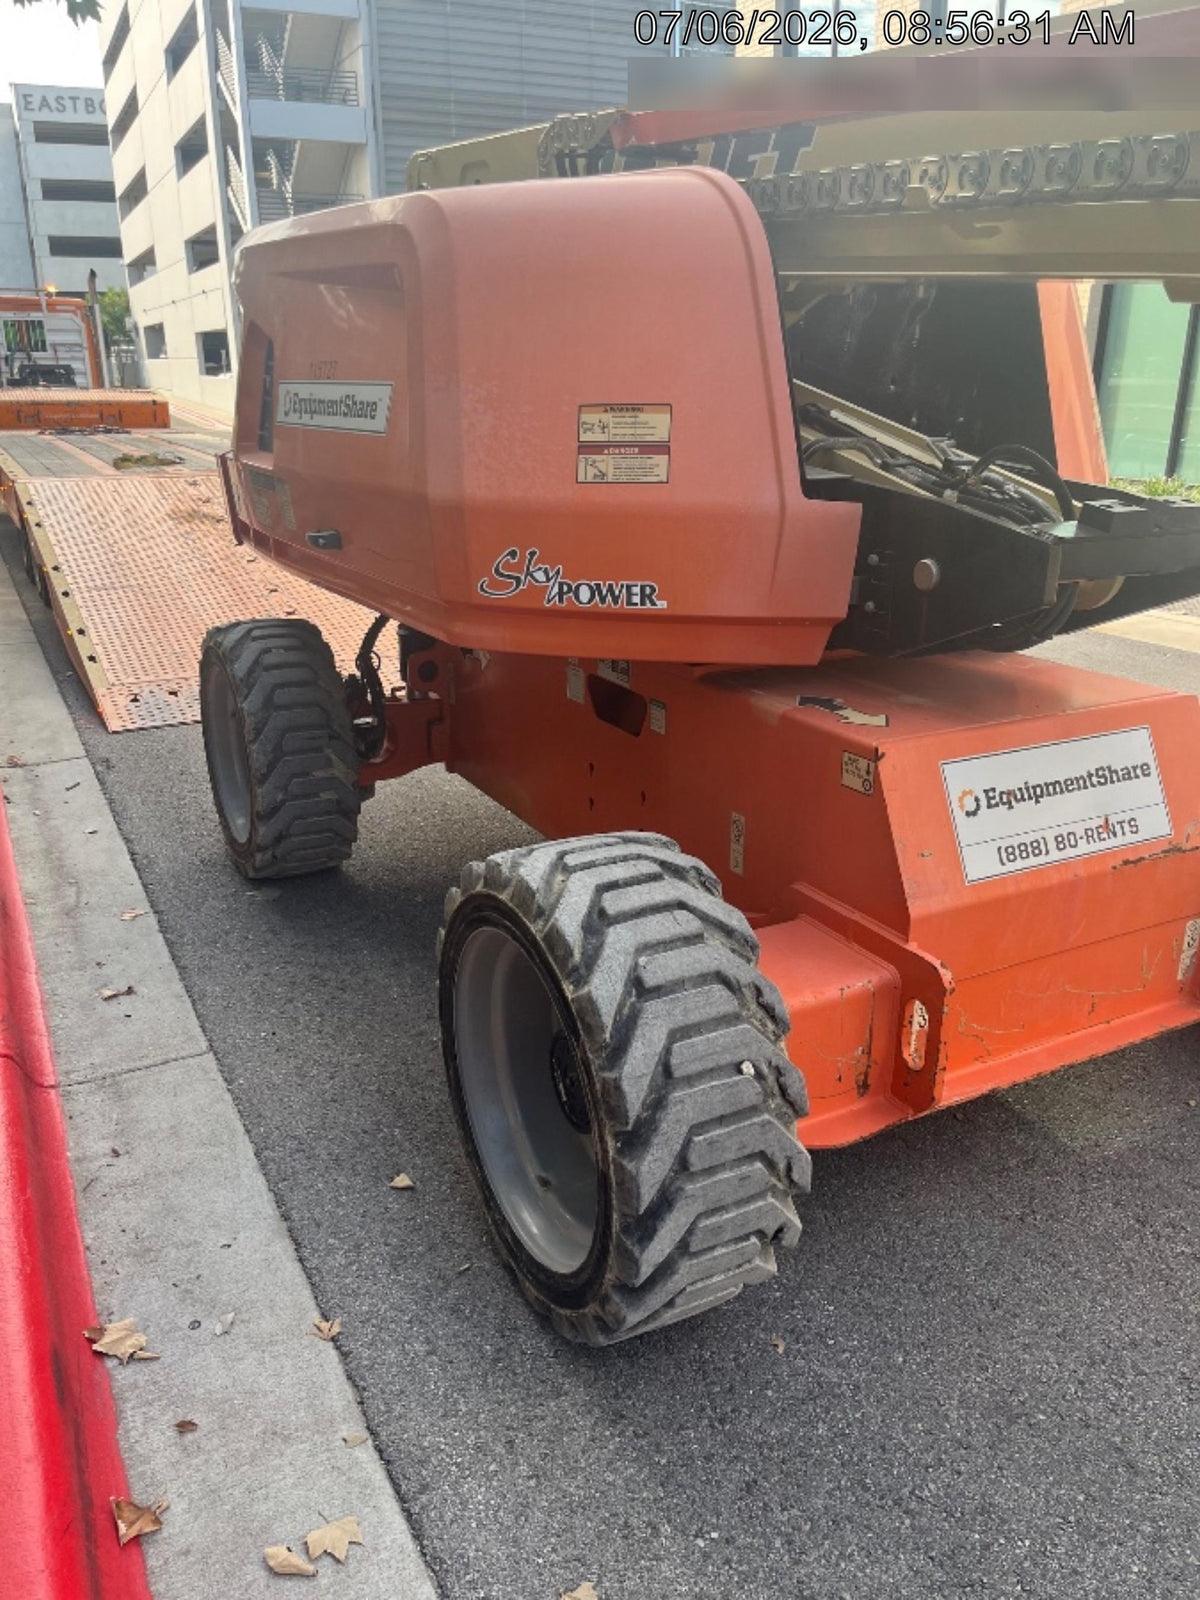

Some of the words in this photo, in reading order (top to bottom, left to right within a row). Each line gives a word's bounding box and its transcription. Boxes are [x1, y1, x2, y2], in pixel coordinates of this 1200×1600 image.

[292, 392, 379, 421] EquipmentShare
[982, 761, 1152, 811] EquipmentShare
[997, 836, 1050, 866] (888)
[1054, 817, 1140, 852] 80-RENTS
